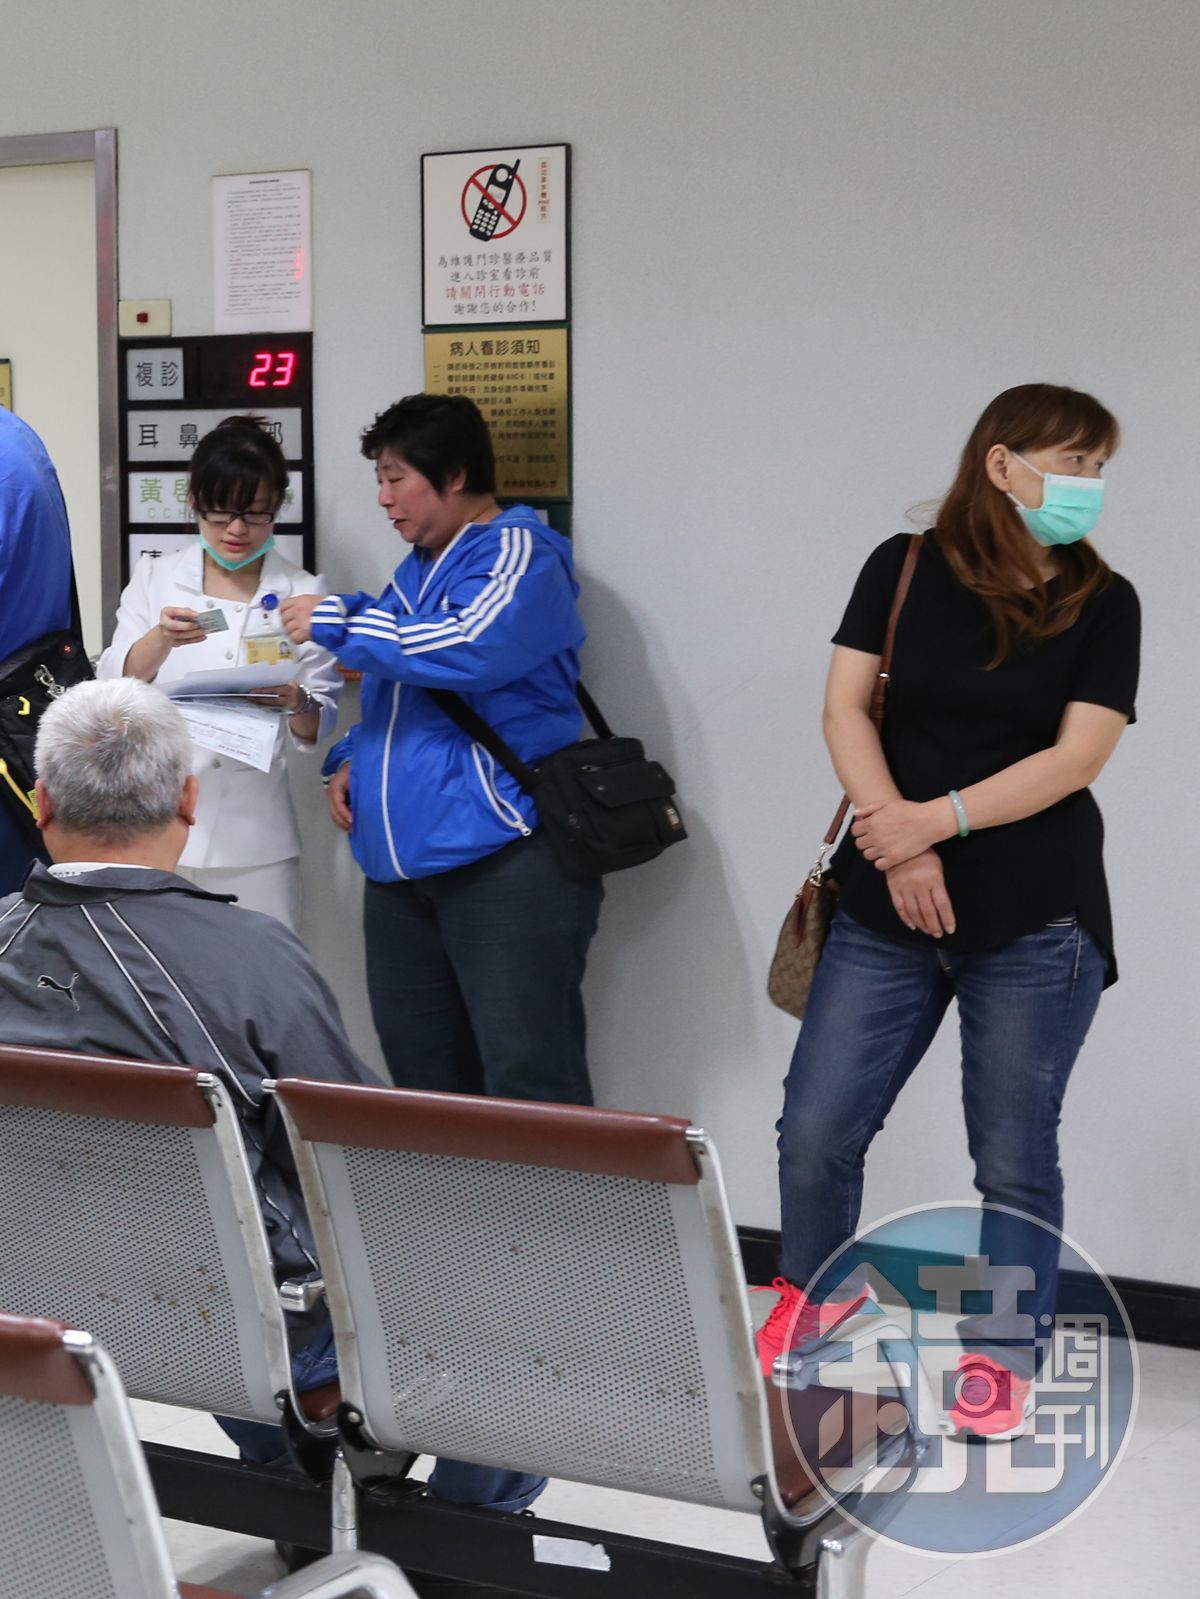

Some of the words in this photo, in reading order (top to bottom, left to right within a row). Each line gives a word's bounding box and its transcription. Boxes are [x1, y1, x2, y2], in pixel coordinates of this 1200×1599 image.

[450, 339, 540, 357] 病人看診須知
[135, 361, 178, 387] 複診
[249, 352, 295, 387] 23
